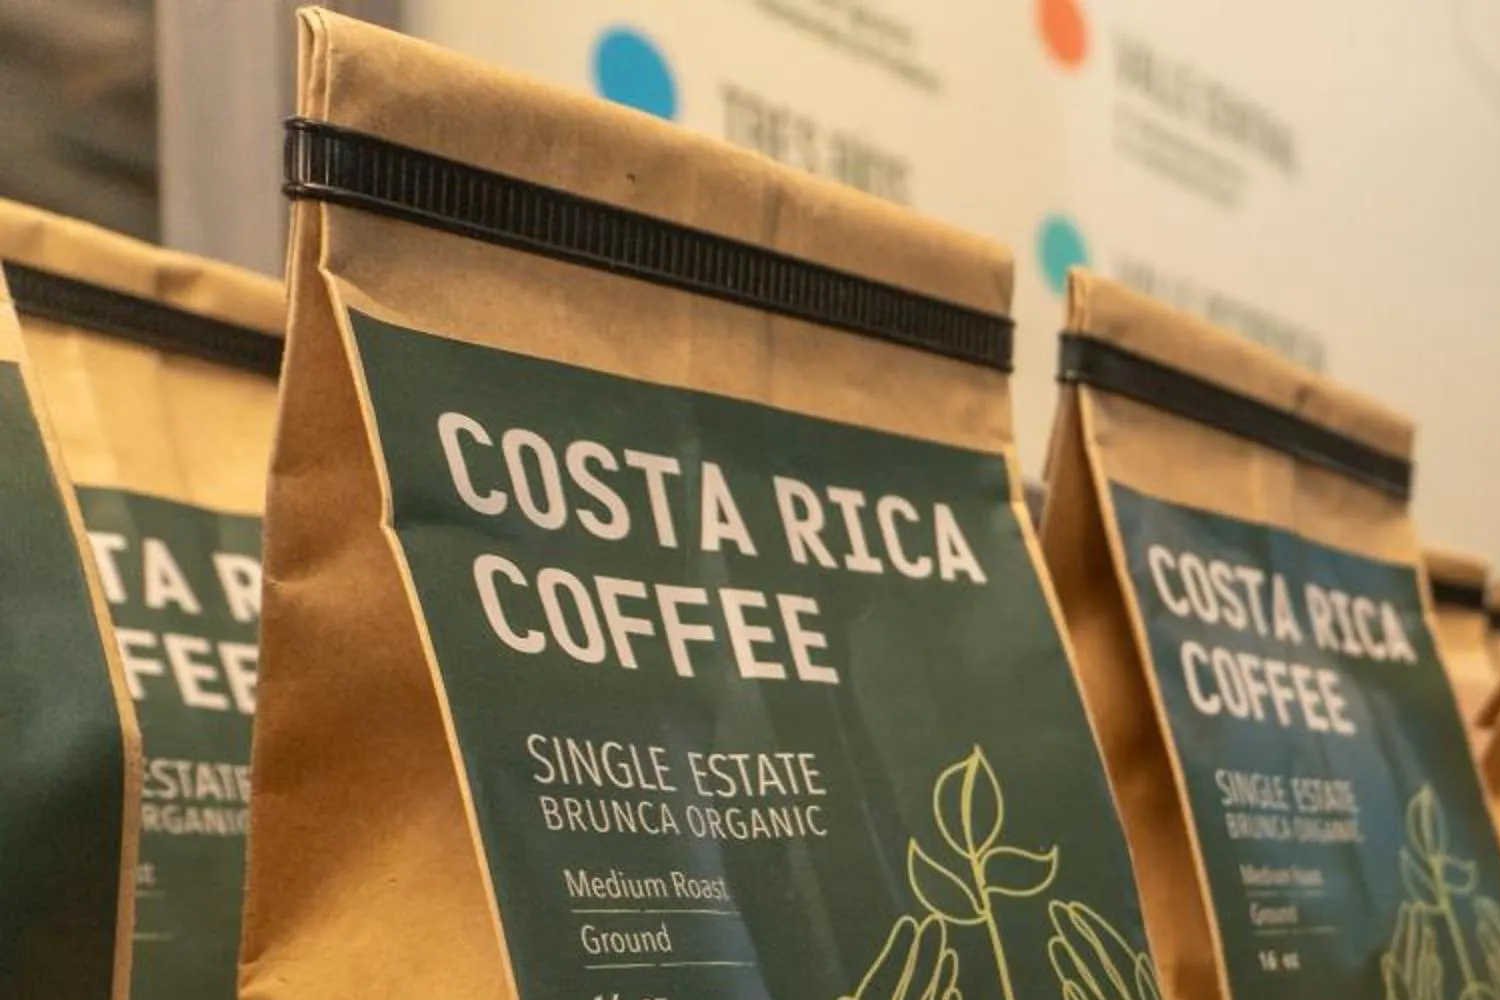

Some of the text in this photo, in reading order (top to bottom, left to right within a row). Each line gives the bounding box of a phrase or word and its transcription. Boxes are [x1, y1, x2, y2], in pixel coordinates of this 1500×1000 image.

[436, 411, 988, 585] COSTA RICA
[472, 553, 840, 685] COFFEE
[1147, 544, 1418, 664] COSTA RICA
[113, 627, 259, 714] FEE
[1180, 641, 1357, 735] COFFEE
[526, 733, 828, 797] SINGLE ESTATE
[1215, 768, 1290, 811] SINGLE
[142, 803, 250, 835] RGANI
[539, 796, 828, 840] BRUNCA ORGANIC
[562, 868, 731, 902] Medium Roast
[580, 919, 673, 955] Ground
